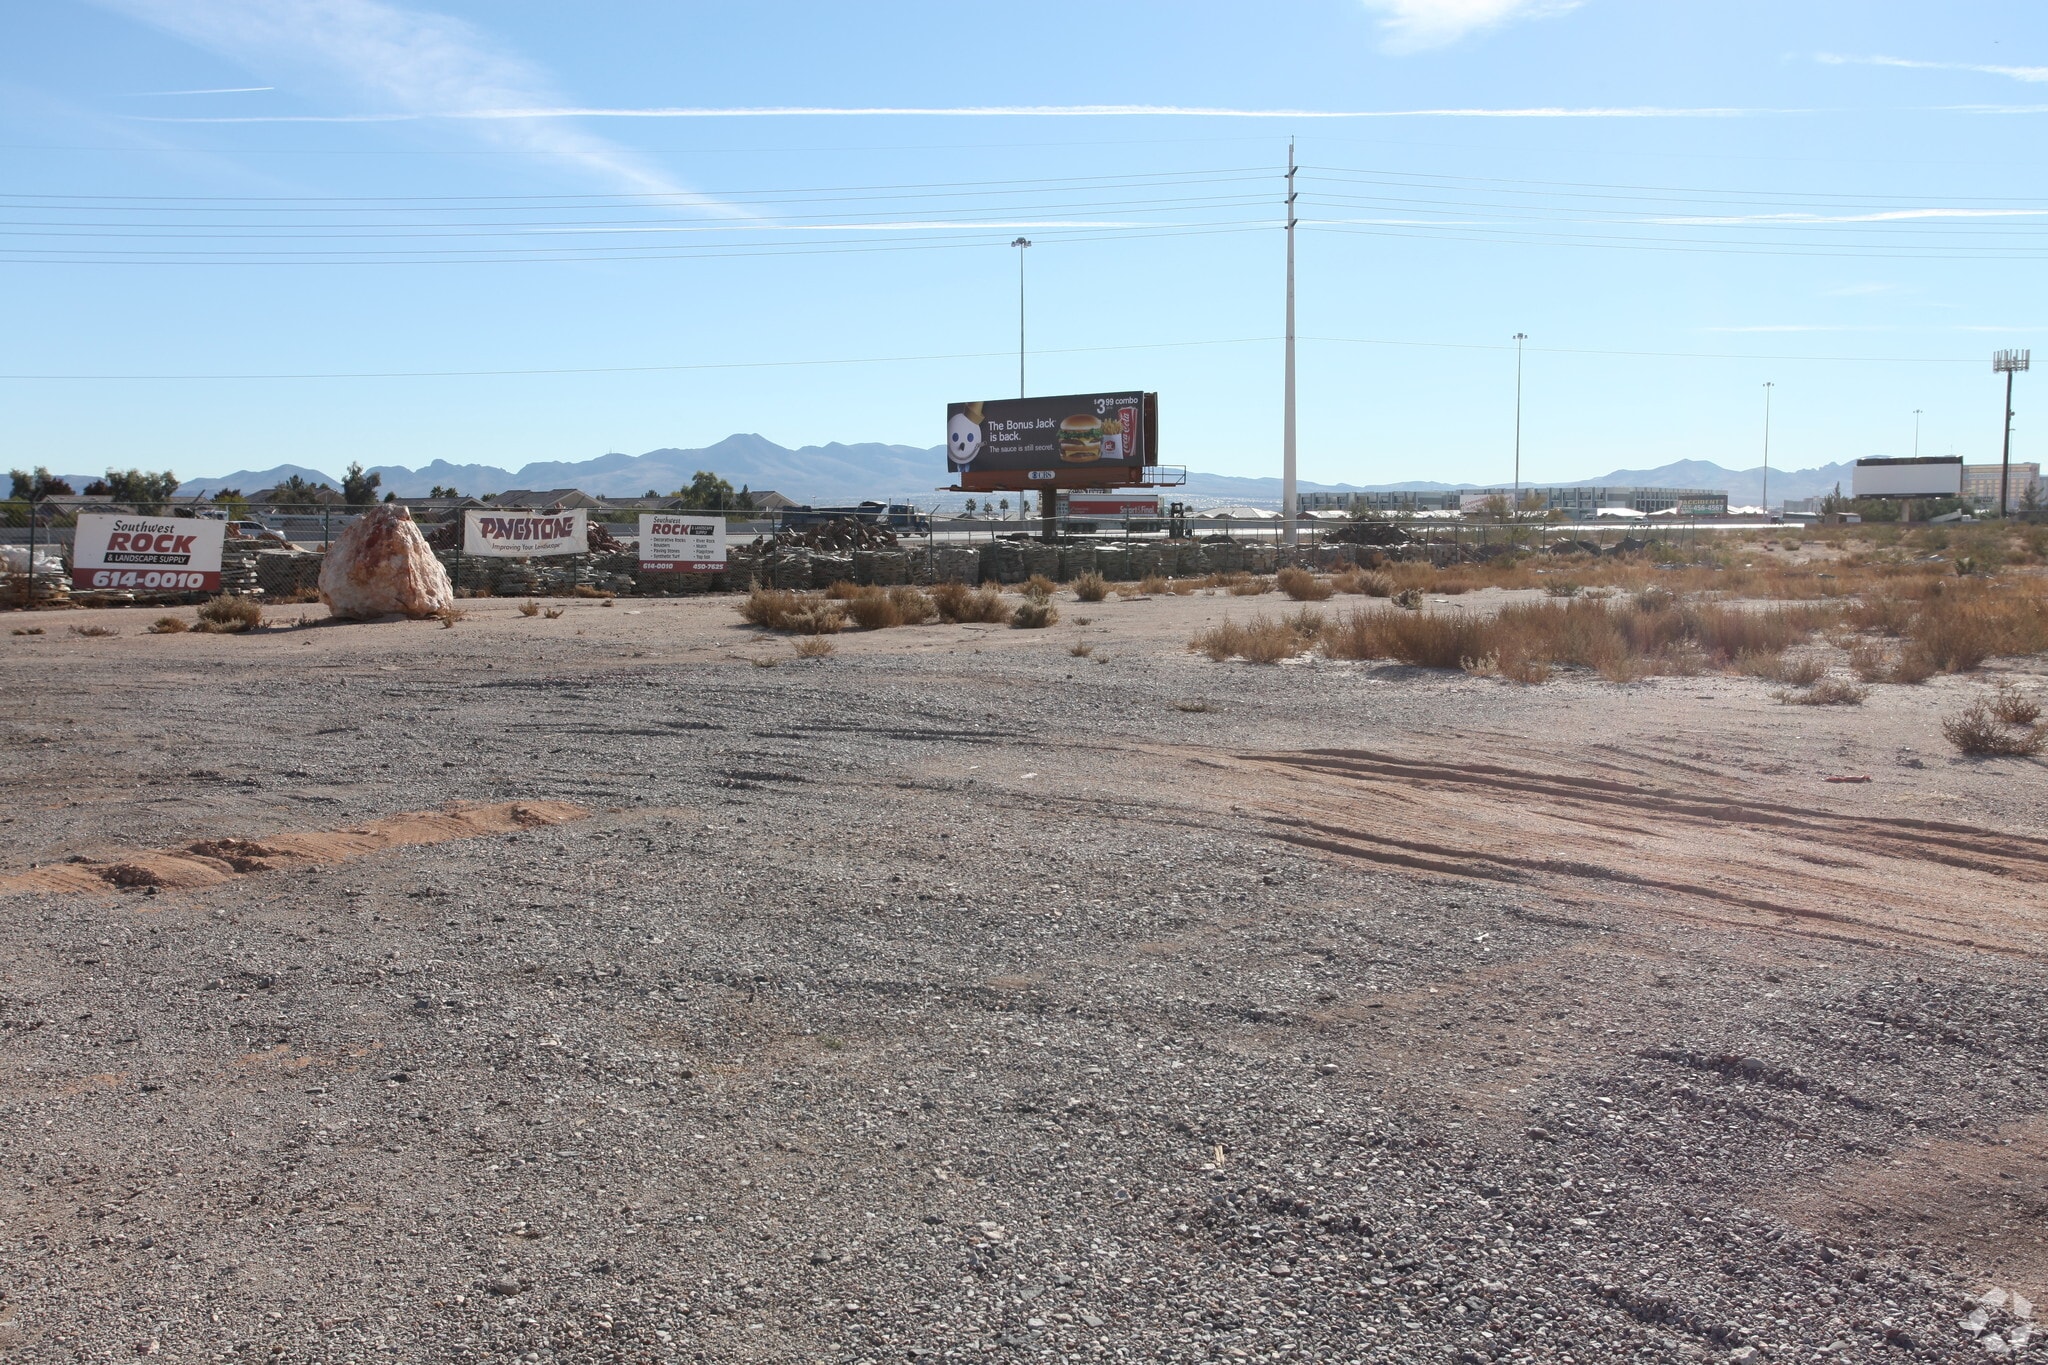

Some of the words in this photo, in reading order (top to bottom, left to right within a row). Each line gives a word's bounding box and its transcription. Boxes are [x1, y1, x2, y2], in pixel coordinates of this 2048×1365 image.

[1115, 396, 1139, 405] combo
[988, 420, 1004, 431] The
[1006, 420, 1034, 430] Bonus
[1035, 417, 1055, 429] Jack
[989, 432, 997, 442] is
[999, 431, 1022, 442] back.
[989, 445, 1000, 453] The
[1000, 445, 1017, 453] sauce
[1024, 444, 1034, 452] still
[1034, 443, 1055, 451] secret.
[1038, 471, 1052, 479] CBS
[653, 515, 681, 524] Southwest
[113, 520, 175, 534] Southwest
[651, 523, 691, 536] ROCK
[107, 533, 197, 553] ROCK
[491, 542, 521, 552] Improving
[522, 542, 534, 550] Your
[107, 554, 113, 562] &
[114, 554, 158, 563] LANDSCAPE
[159, 555, 187, 564] SUPPLY
[642, 562, 673, 570] 614-0010
[92, 570, 204, 589] 614-0010
